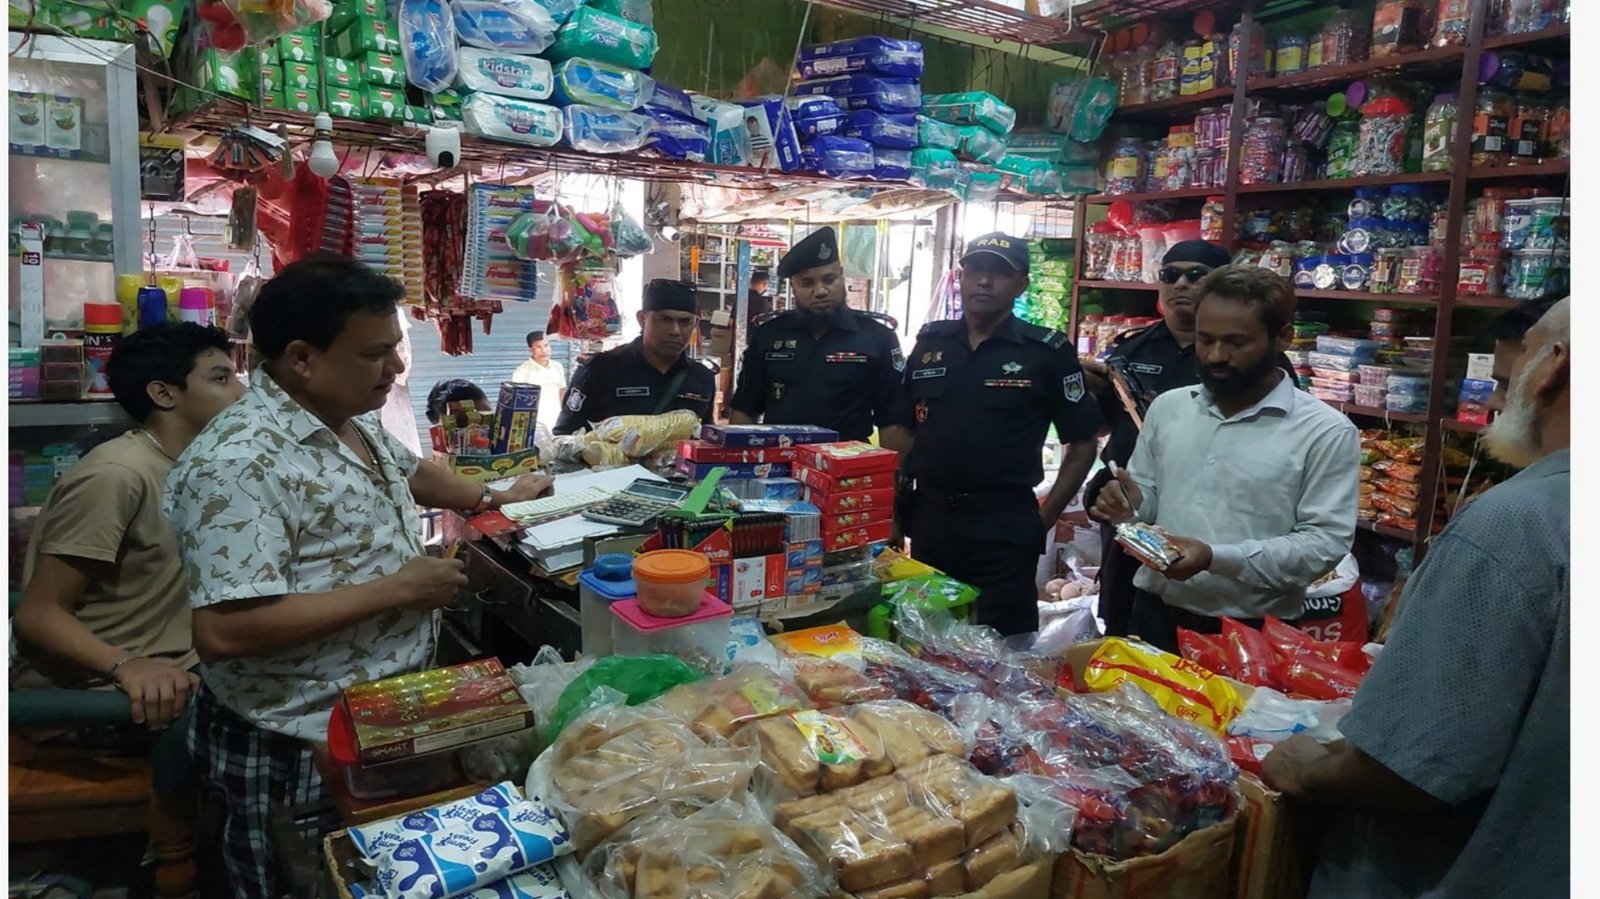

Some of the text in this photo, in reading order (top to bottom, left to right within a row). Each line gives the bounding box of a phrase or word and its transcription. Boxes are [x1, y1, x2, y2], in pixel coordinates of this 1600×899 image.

[483, 59, 530, 77] kidstar
[977, 238, 1010, 248] RAB
[28, 253, 39, 264] 10
[383, 831, 404, 843] resh
[446, 839, 471, 852] Farm
